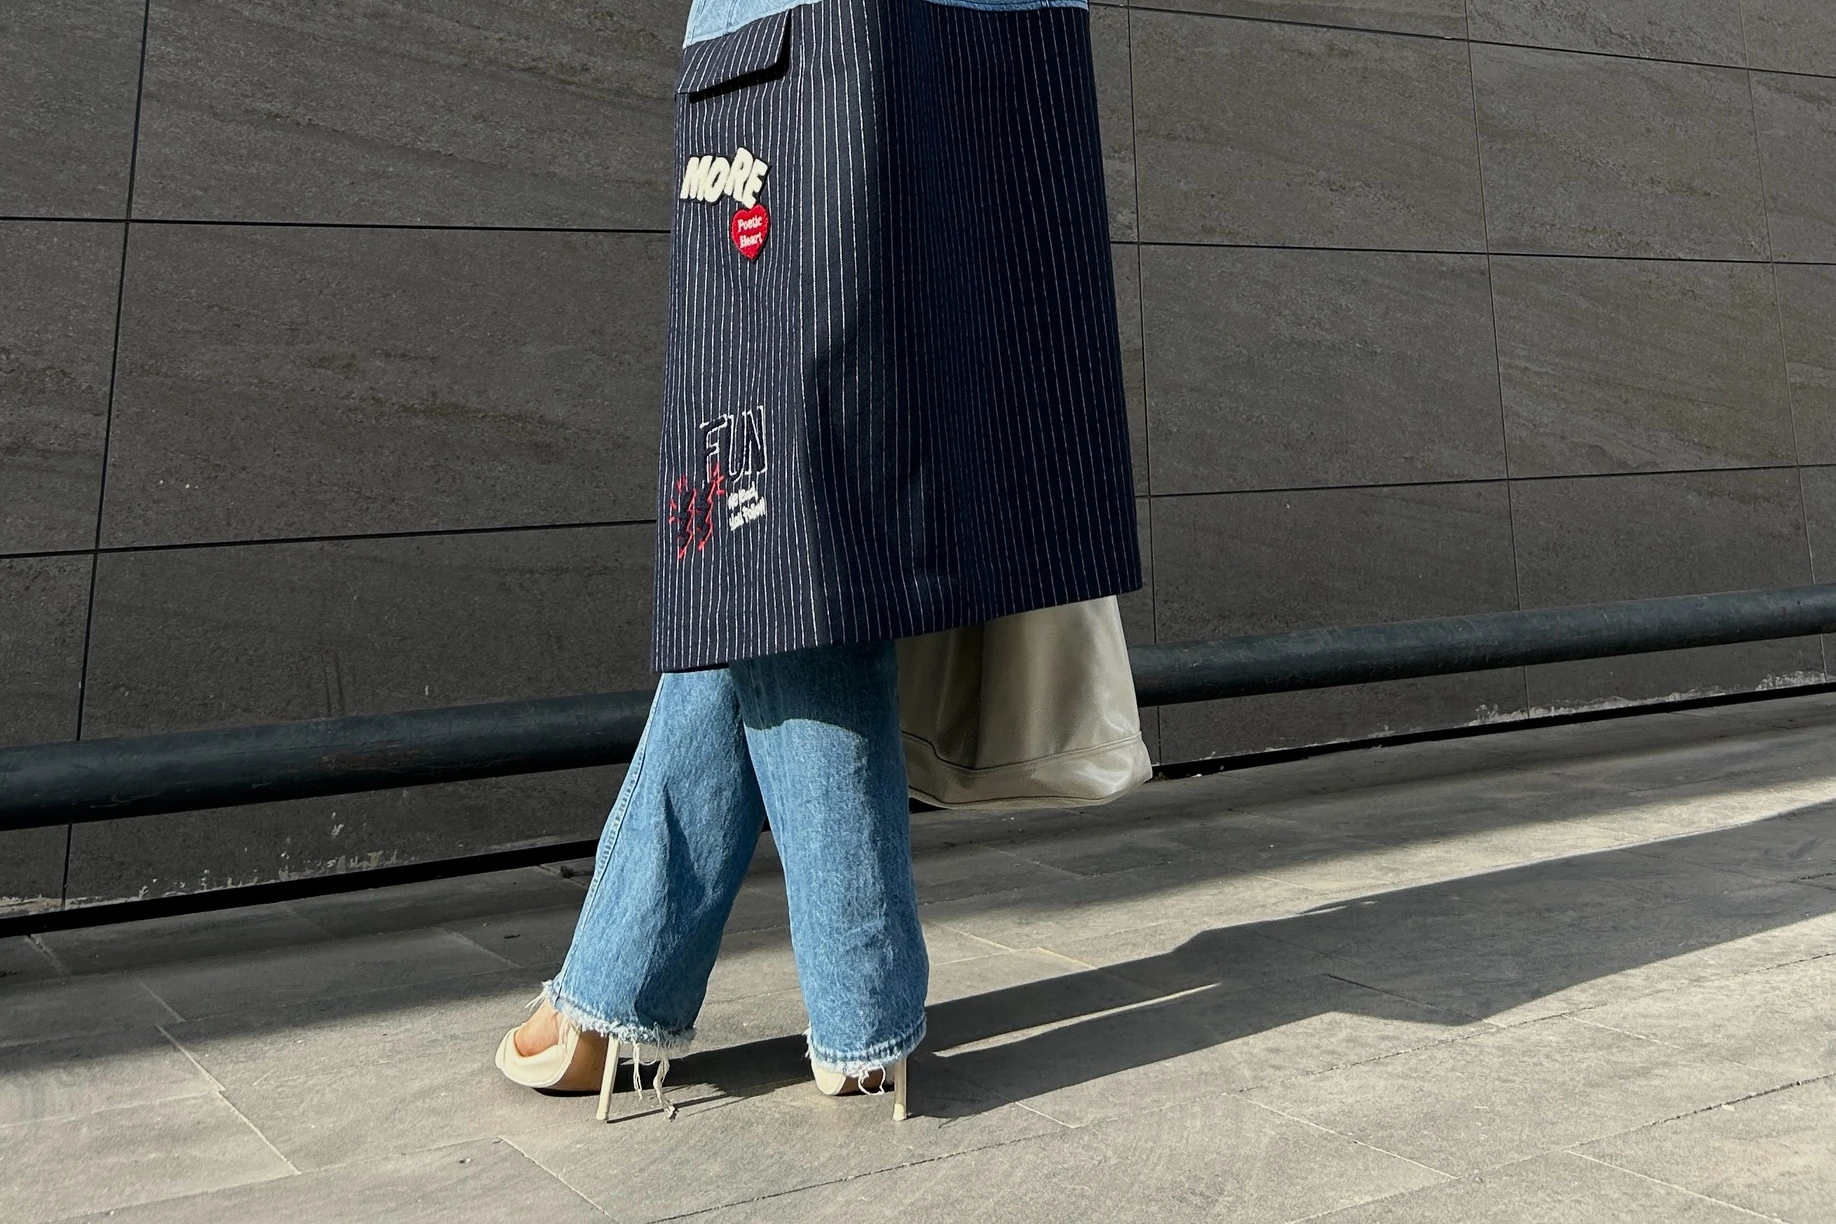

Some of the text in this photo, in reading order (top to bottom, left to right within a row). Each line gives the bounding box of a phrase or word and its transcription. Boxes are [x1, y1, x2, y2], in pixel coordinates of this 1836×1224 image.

[679, 146, 769, 210] MORE
[737, 215, 763, 233] Poetic
[740, 231, 763, 249] Heart
[699, 404, 768, 488] FUN
